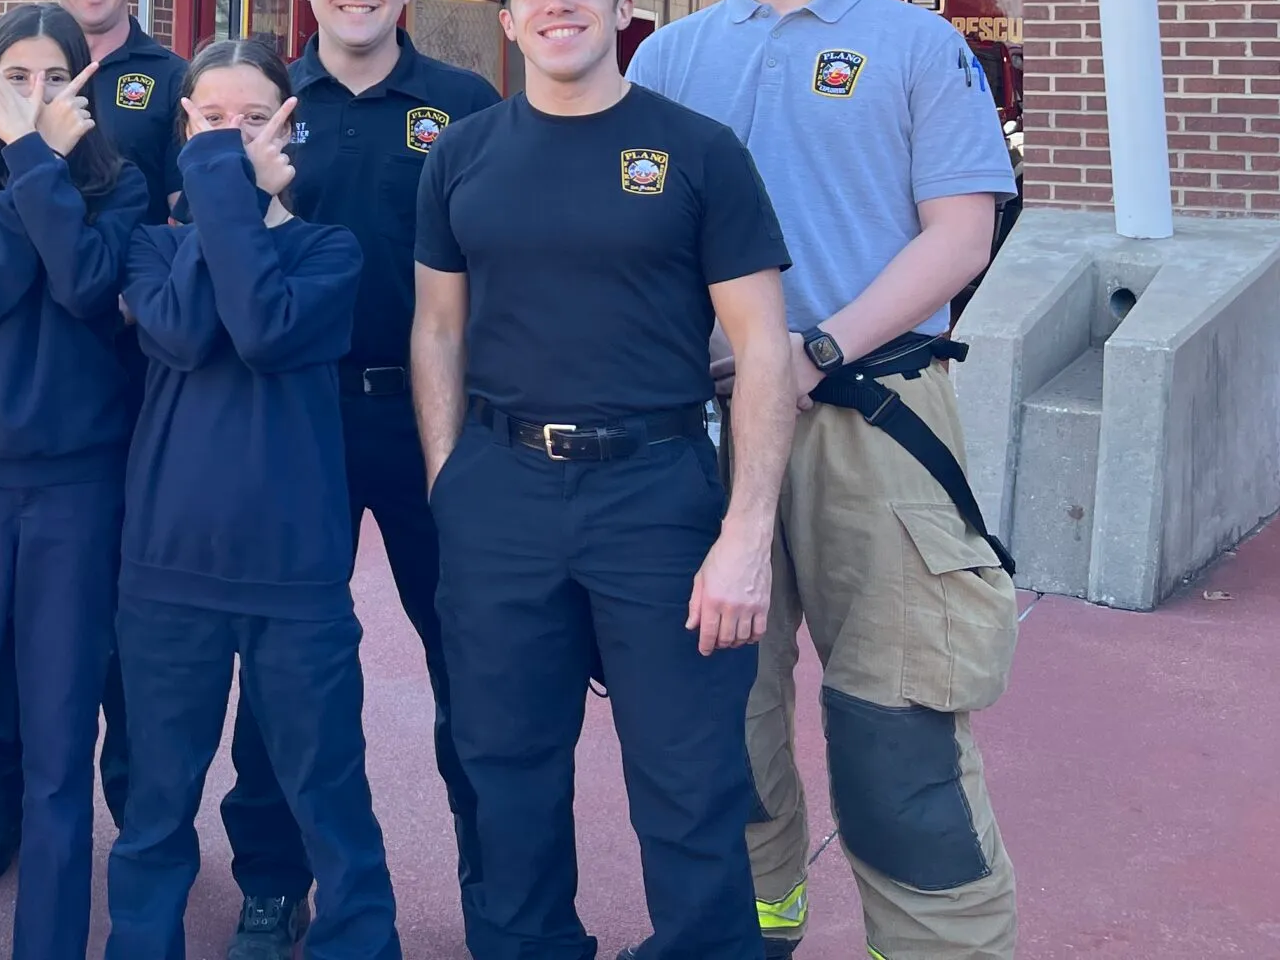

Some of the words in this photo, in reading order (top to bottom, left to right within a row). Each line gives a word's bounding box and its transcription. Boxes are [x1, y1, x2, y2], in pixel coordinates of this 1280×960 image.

[823, 52, 862, 64] PLANO
[122, 76, 152, 86] PLANO
[410, 111, 446, 124] PLANO
[624, 151, 666, 164] PLANO
